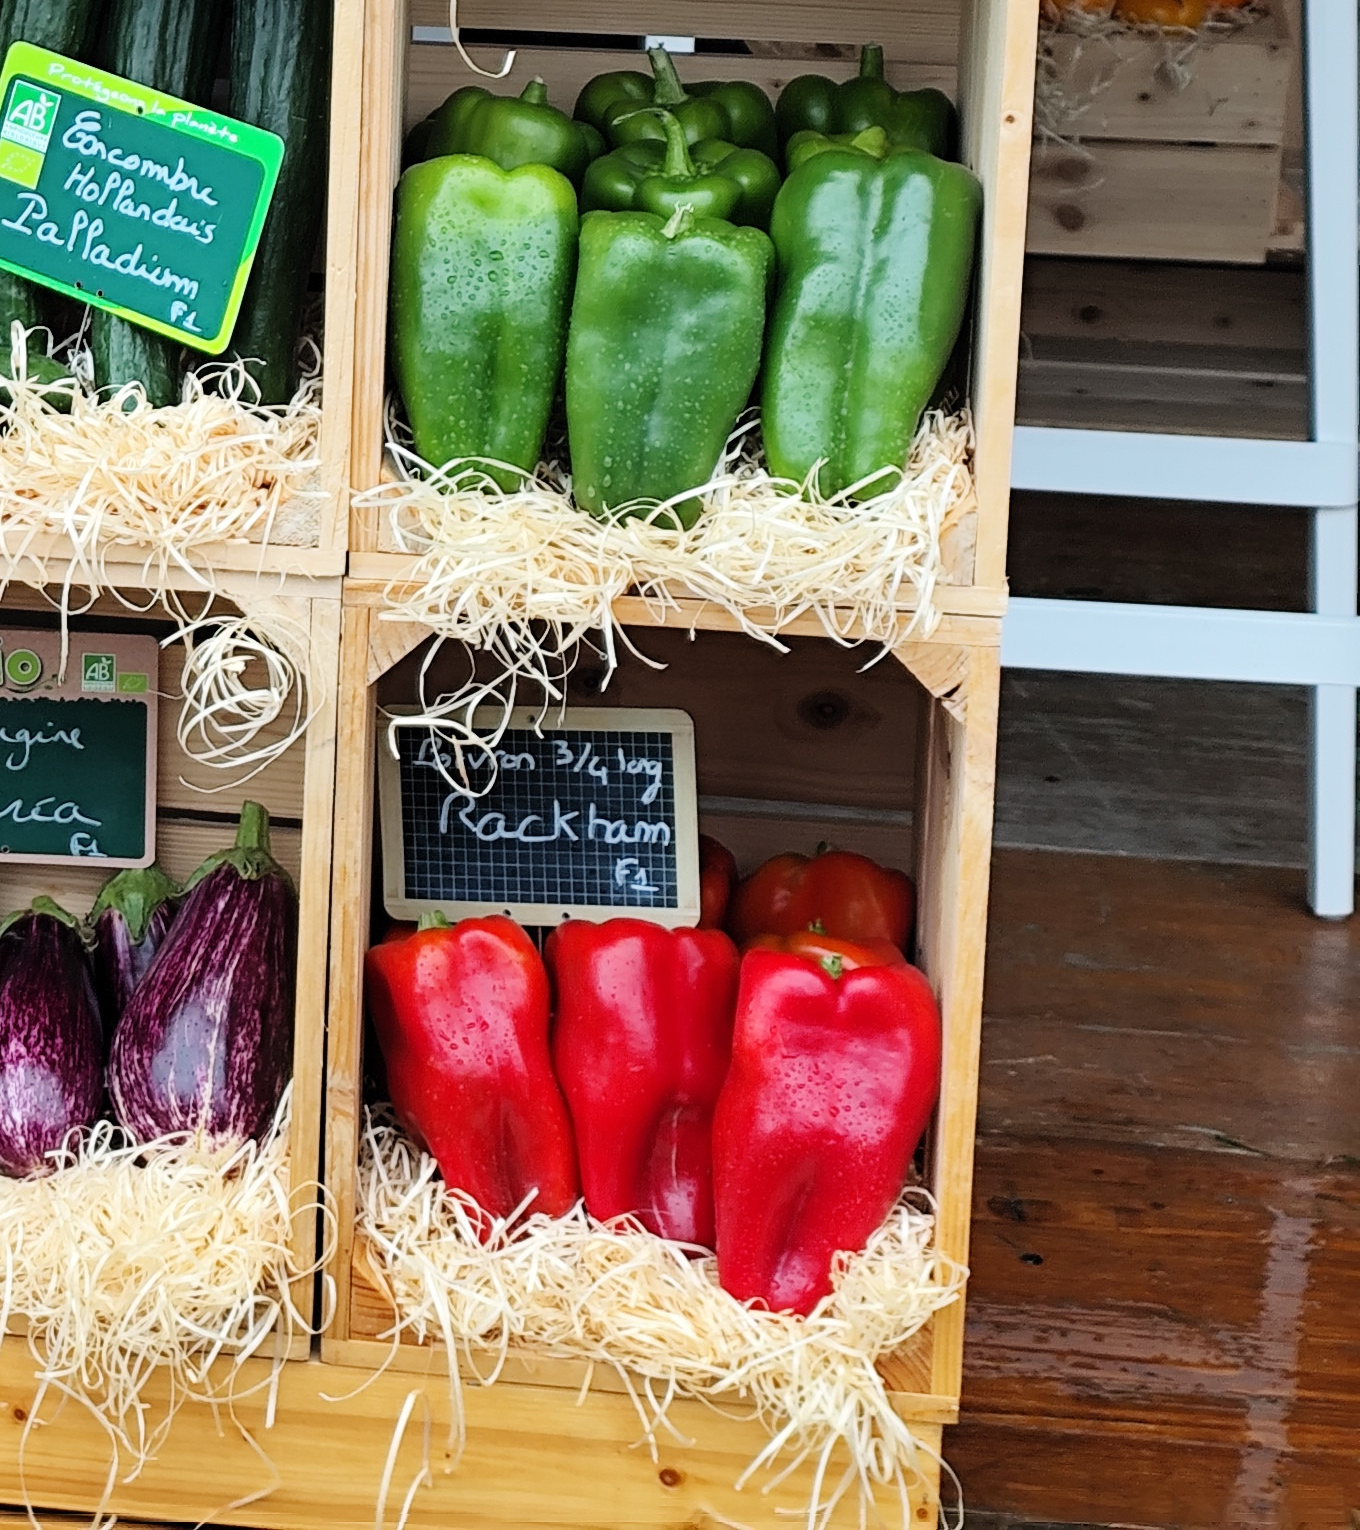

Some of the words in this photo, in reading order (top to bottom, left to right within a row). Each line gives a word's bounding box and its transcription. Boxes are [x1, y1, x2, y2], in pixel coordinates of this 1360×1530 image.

[9, 99, 46, 131] AB
[169, 300, 203, 333] F1
[85, 661, 110, 681] AB
[440, 791, 670, 847] Rackham
[615, 858, 660, 892] F1
